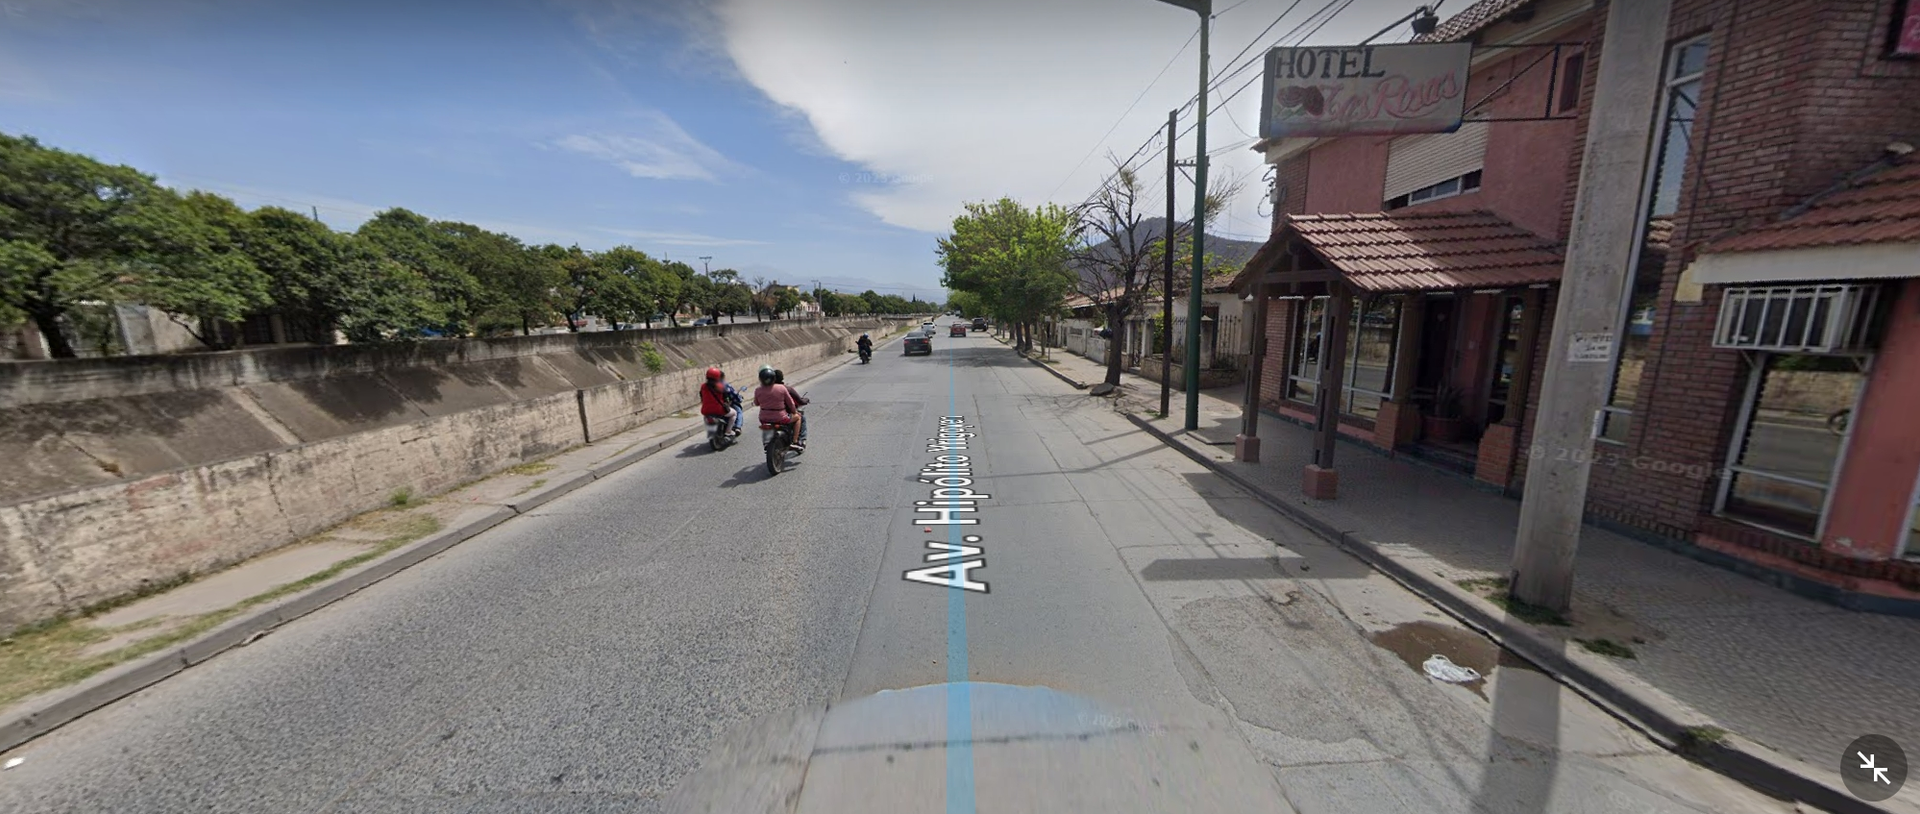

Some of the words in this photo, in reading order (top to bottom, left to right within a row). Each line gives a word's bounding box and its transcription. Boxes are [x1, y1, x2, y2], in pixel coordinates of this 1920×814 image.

[1274, 47, 1386, 79] HOTEL
[1317, 83, 1370, 122] Las
[1369, 69, 1462, 120] Rosas
